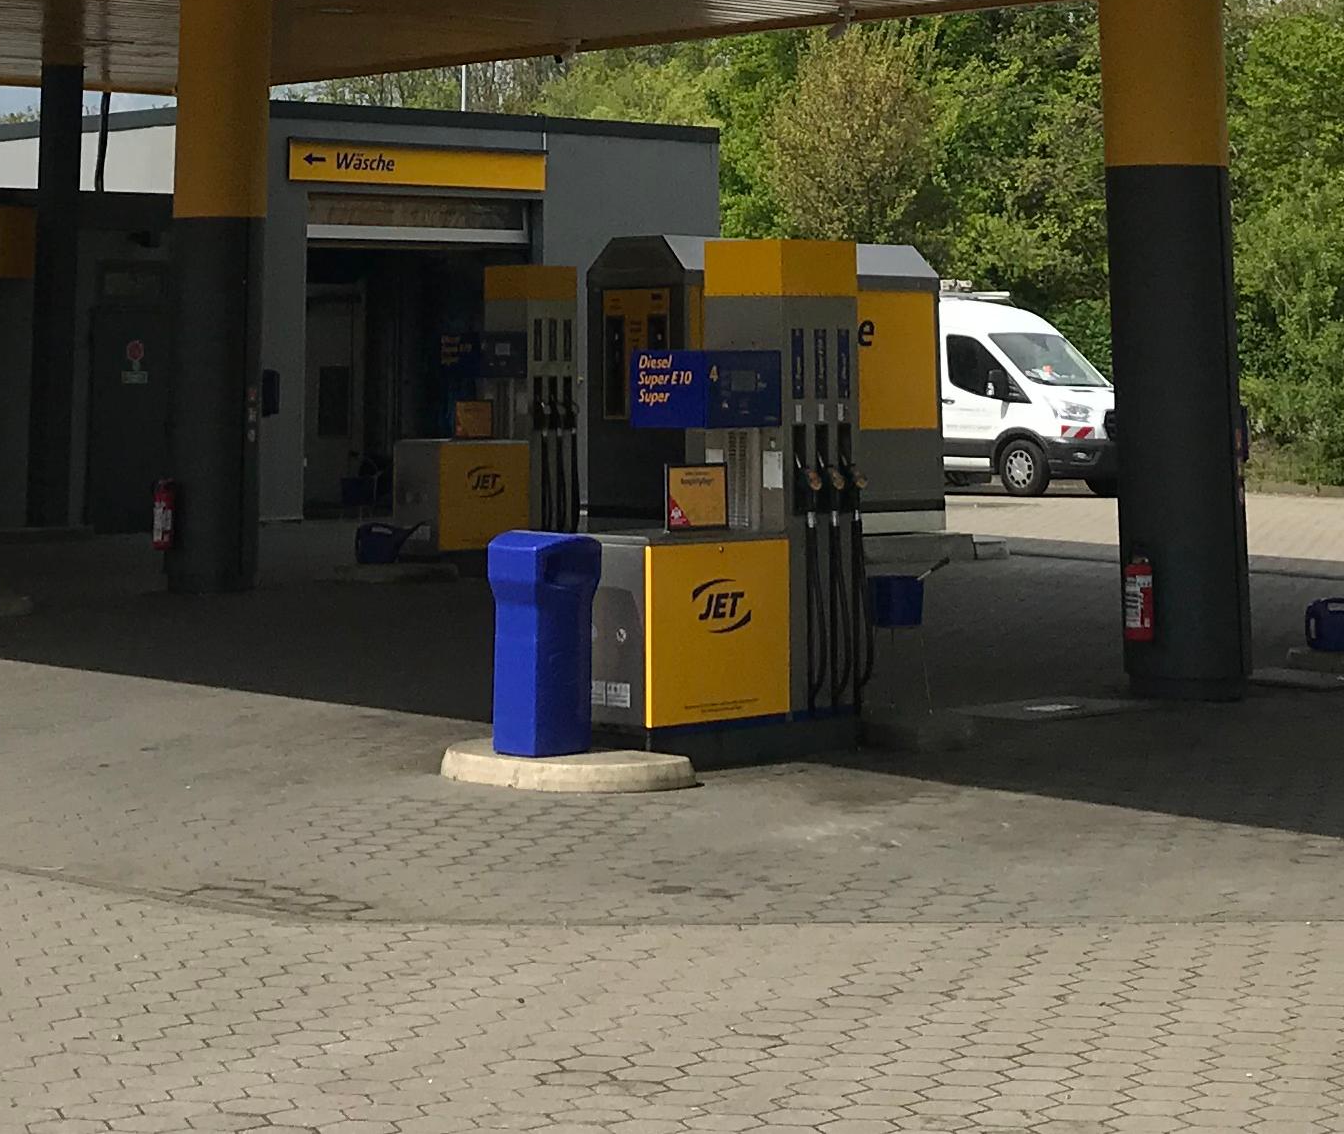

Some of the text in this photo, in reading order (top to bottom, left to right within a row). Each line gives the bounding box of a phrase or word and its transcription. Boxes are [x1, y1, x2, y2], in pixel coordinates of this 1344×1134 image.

[336, 151, 395, 172] Wäsche
[638, 354, 673, 369] Diesel
[638, 370, 693, 386] Super E10
[709, 365, 719, 383] 4
[638, 389, 670, 404] Super
[471, 473, 501, 490] JET
[698, 591, 745, 621] JET
